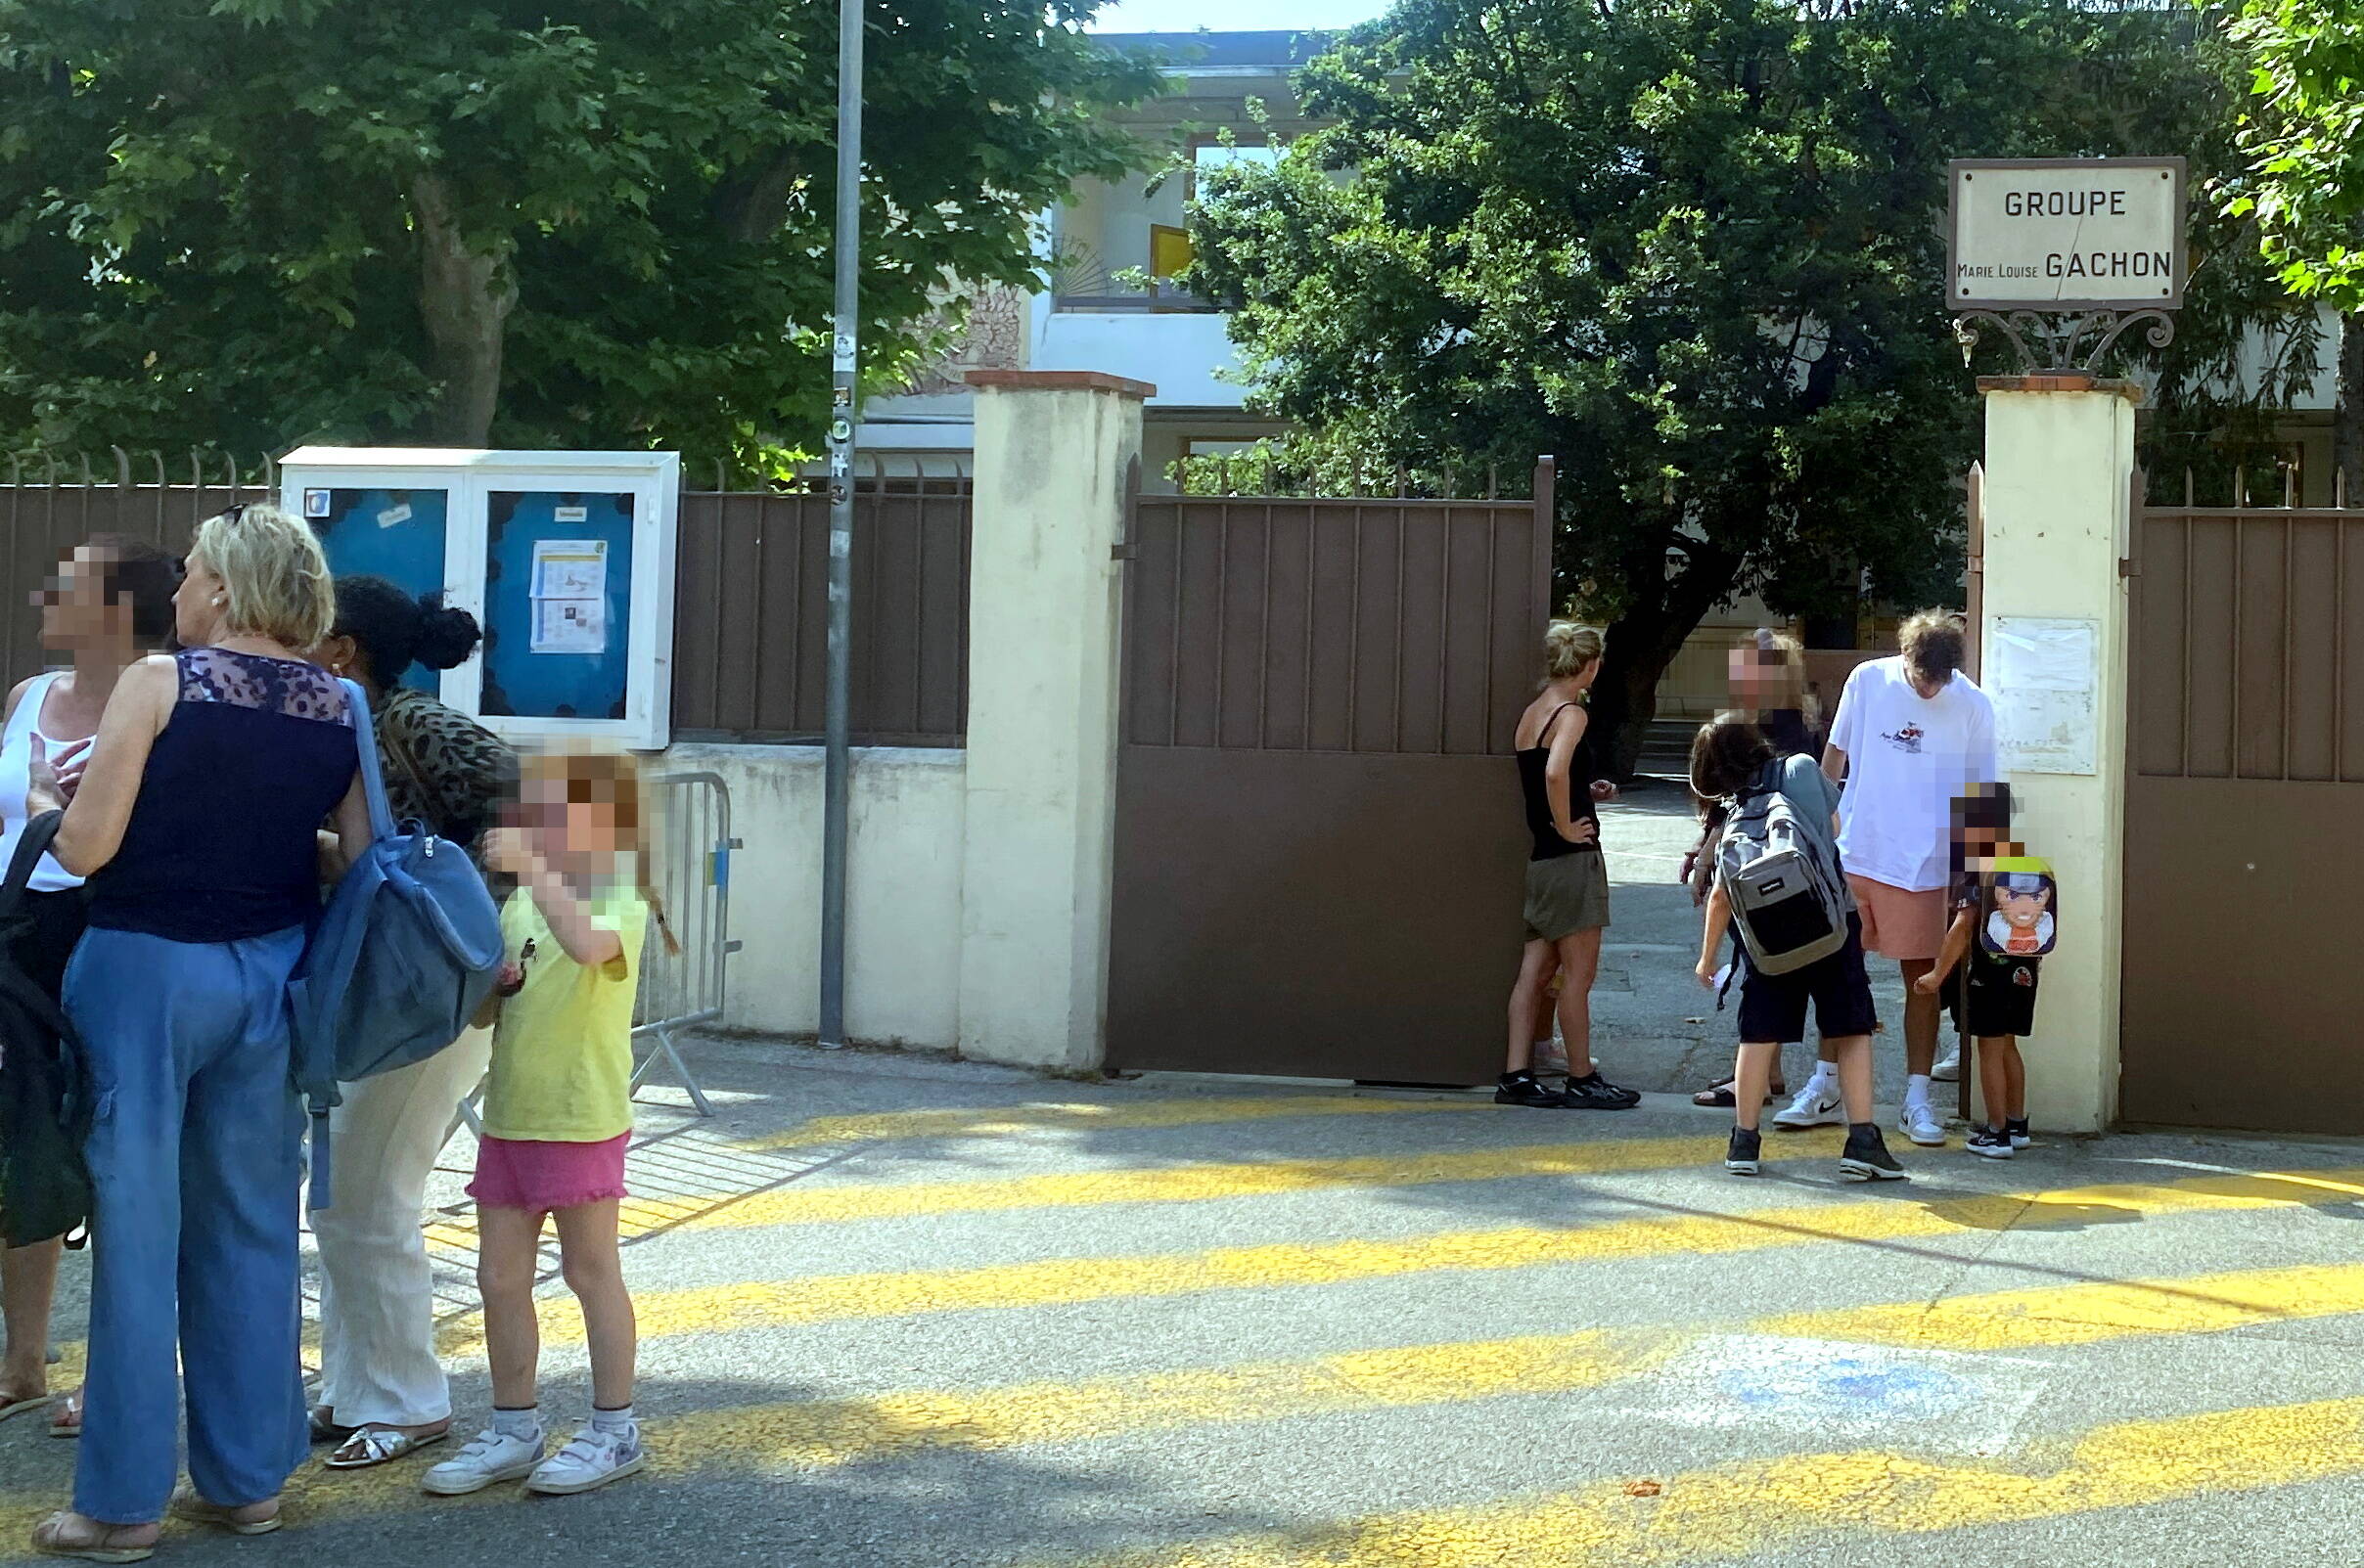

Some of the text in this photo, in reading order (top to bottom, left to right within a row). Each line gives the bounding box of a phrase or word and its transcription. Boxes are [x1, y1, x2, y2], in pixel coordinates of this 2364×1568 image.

[2005, 190, 2126, 217] GROUPE
[1957, 251, 2171, 279] MARIE LOUISE GACHON
